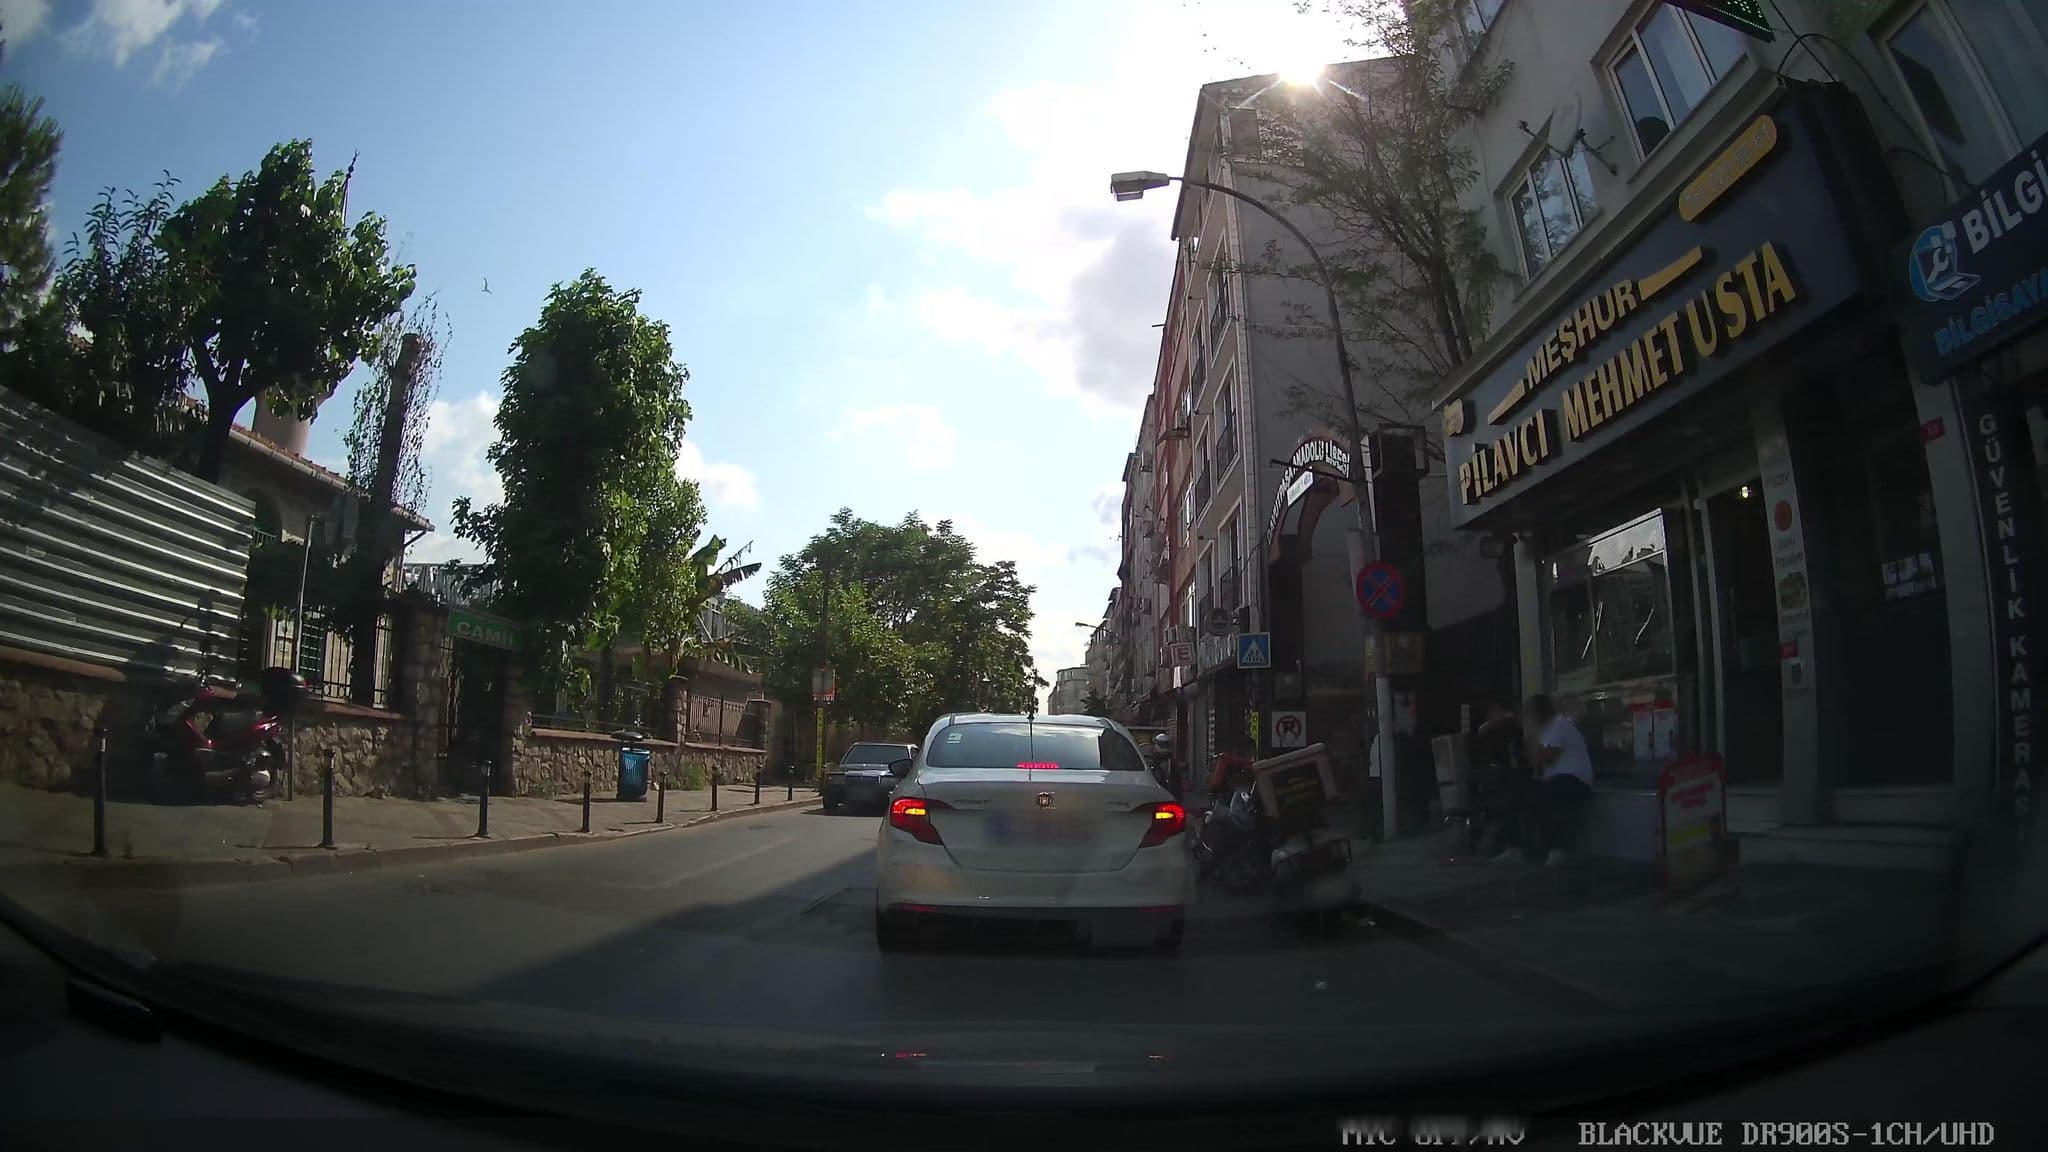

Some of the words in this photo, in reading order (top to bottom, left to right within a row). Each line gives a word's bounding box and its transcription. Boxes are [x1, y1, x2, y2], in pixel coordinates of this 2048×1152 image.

[1458, 408, 1549, 505] PİLAVCI
[1562, 310, 1684, 442] MEHMET
[1686, 240, 1797, 359] USTA
[1525, 278, 1638, 390] MEŞHUR
[1292, 440, 1325, 467] ANADOLU
[1978, 413, 2024, 621] GÜVENLİK
